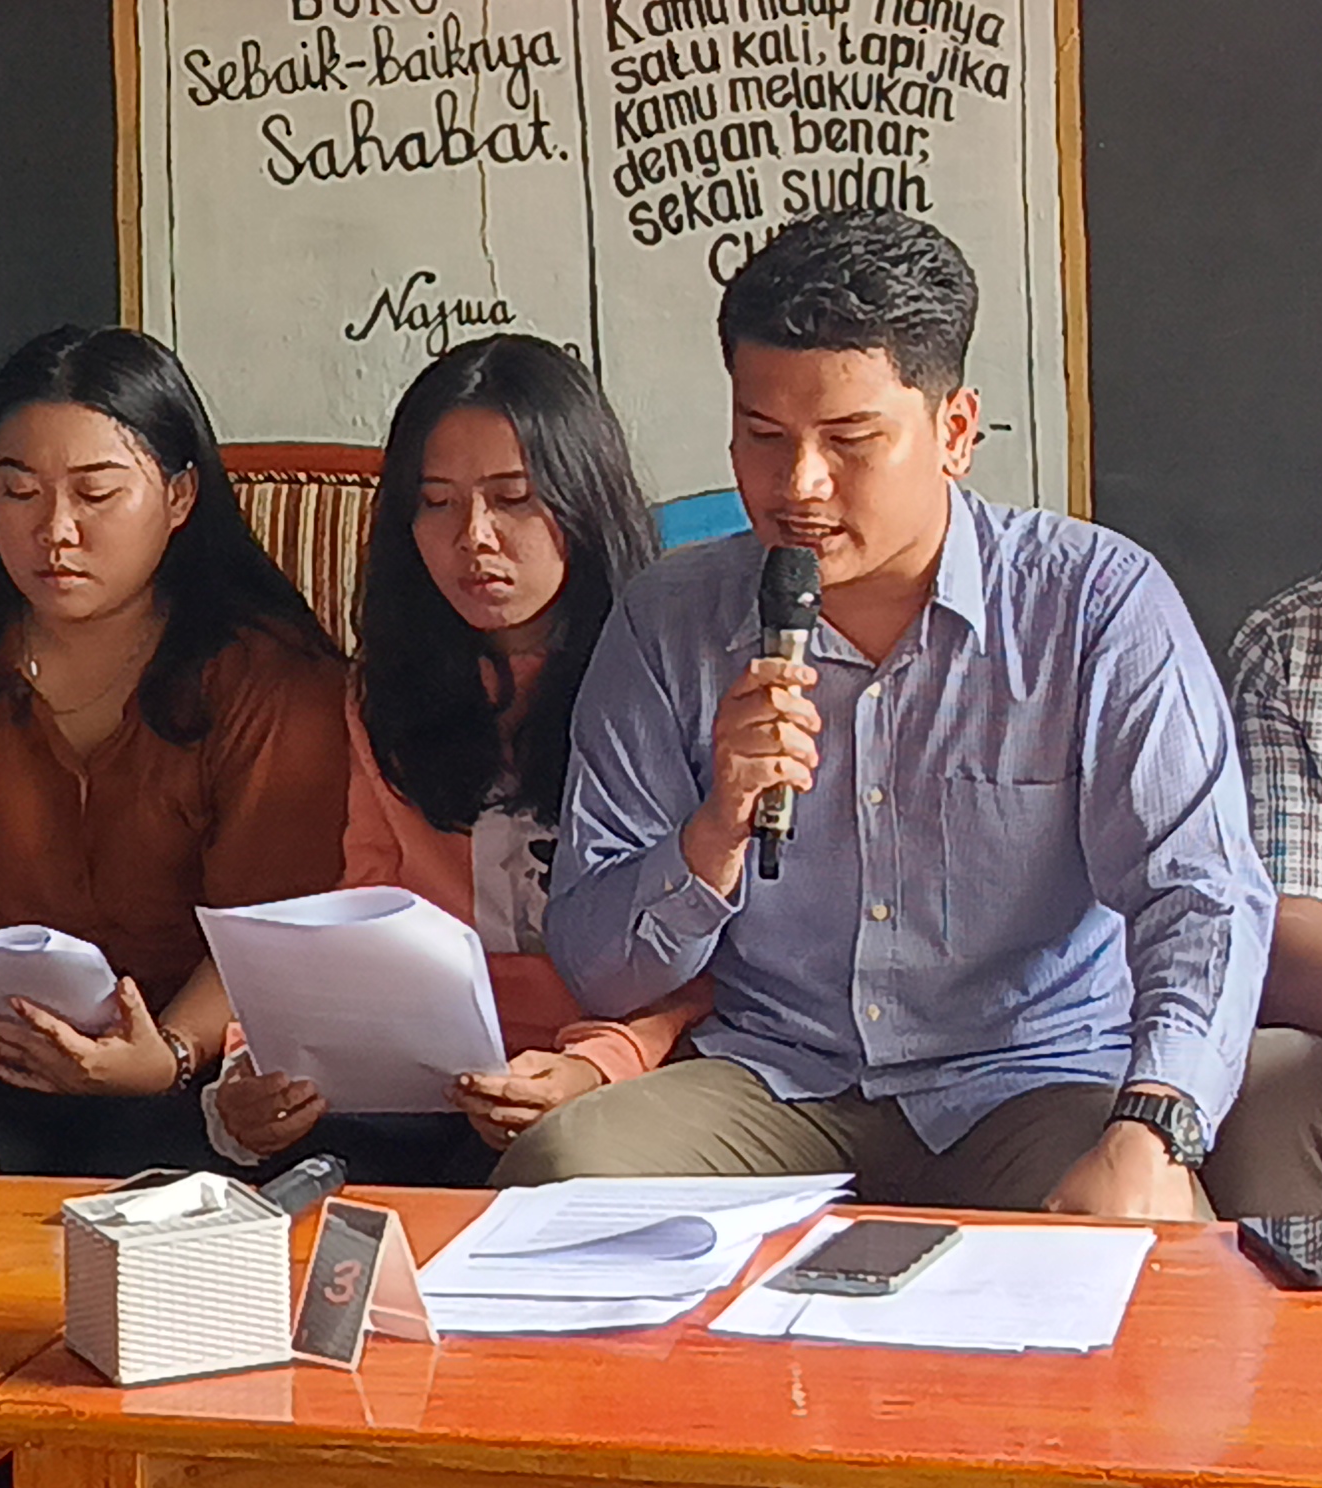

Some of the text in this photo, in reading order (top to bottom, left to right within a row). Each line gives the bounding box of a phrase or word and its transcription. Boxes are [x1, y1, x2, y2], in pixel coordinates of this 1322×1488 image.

[183, 12, 561, 110] Sebaik-baiknya
[610, 21, 1011, 100] satu kali, tapi jika
[729, 66, 956, 122] melakukan
[261, 89, 569, 185] Sahabat.
[613, 117, 780, 198] dengan
[628, 158, 934, 246] sekali sudah
[345, 270, 517, 358] Najwa
[323, 1258, 362, 1305] 3
